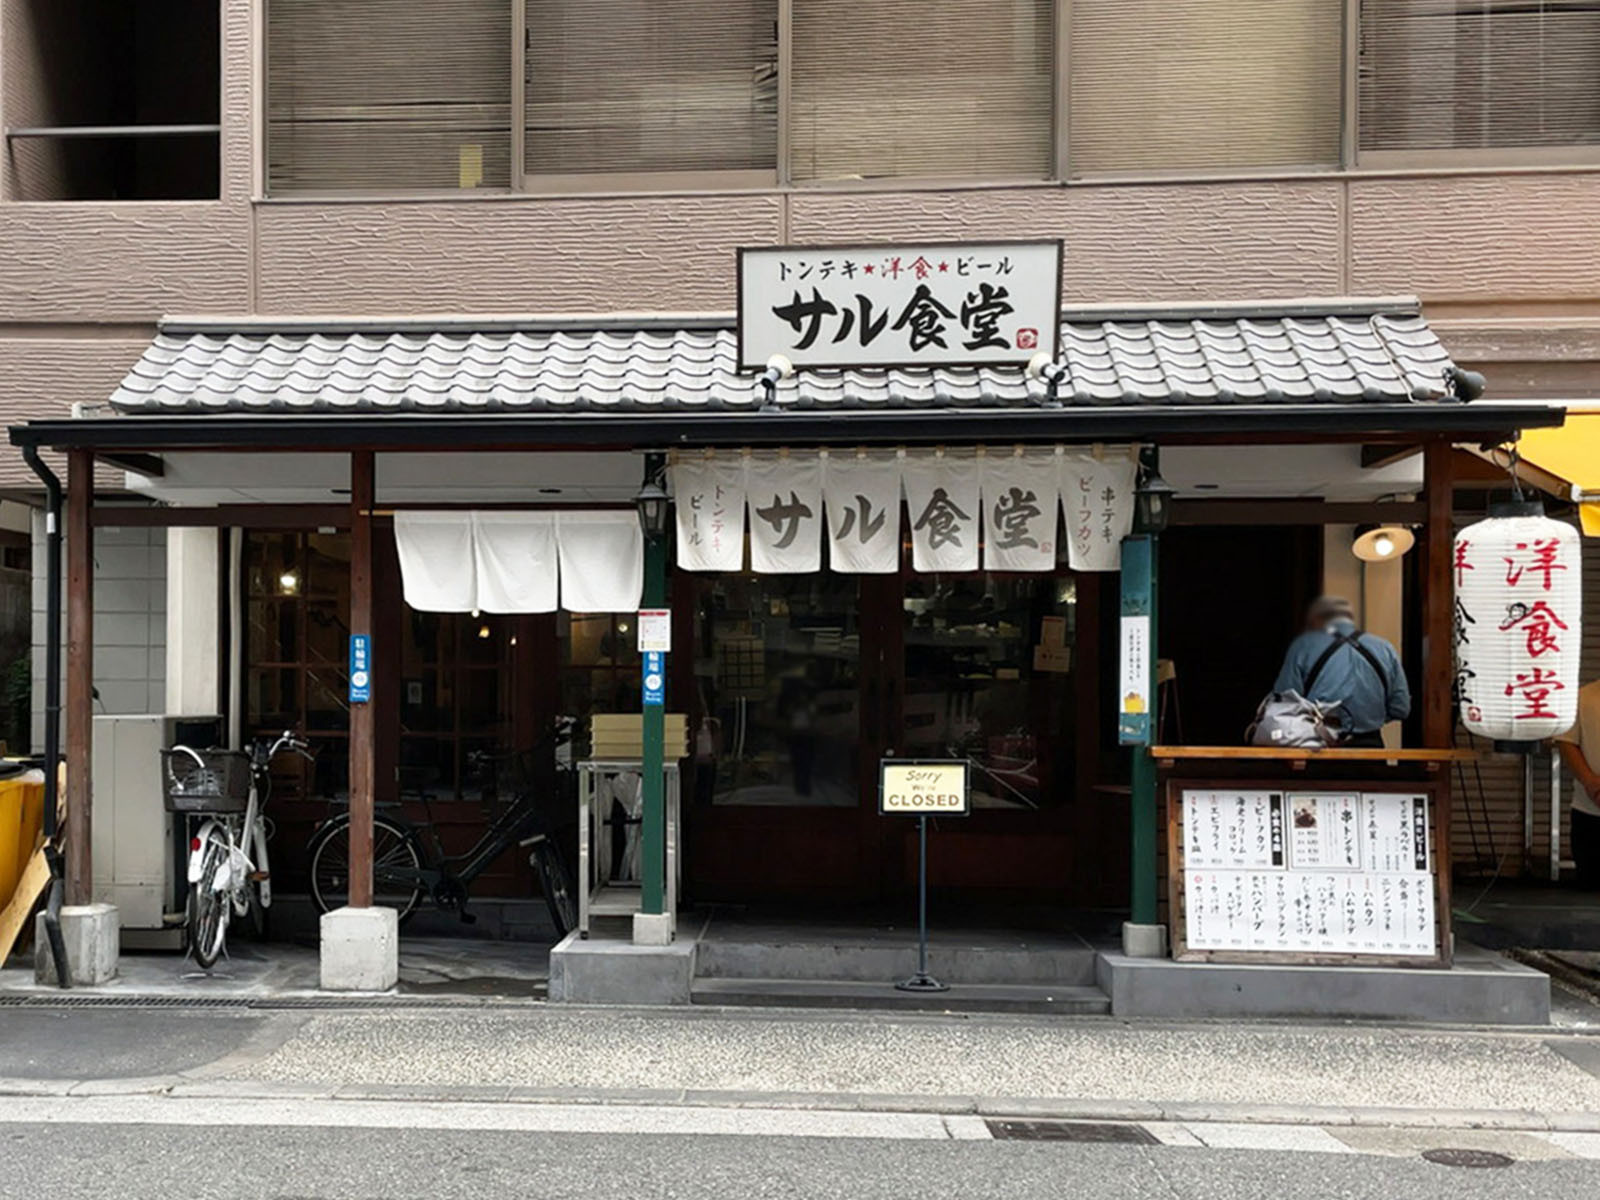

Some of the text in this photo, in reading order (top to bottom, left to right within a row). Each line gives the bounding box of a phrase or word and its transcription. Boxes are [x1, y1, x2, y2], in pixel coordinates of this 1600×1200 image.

[779, 256, 1015, 281] トンテキ 洋食 ビール
[772, 282, 1015, 352] サル食堂
[688, 494, 703, 546] ビール
[755, 487, 1041, 550] サル食堂
[1076, 476, 1094, 558] ビーフカツ
[1100, 486, 1116, 544] 串テキ
[1498, 538, 1568, 719] 洋食堂
[889, 794, 959, 806] CLOSED
[905, 770, 942, 784] Sorry
